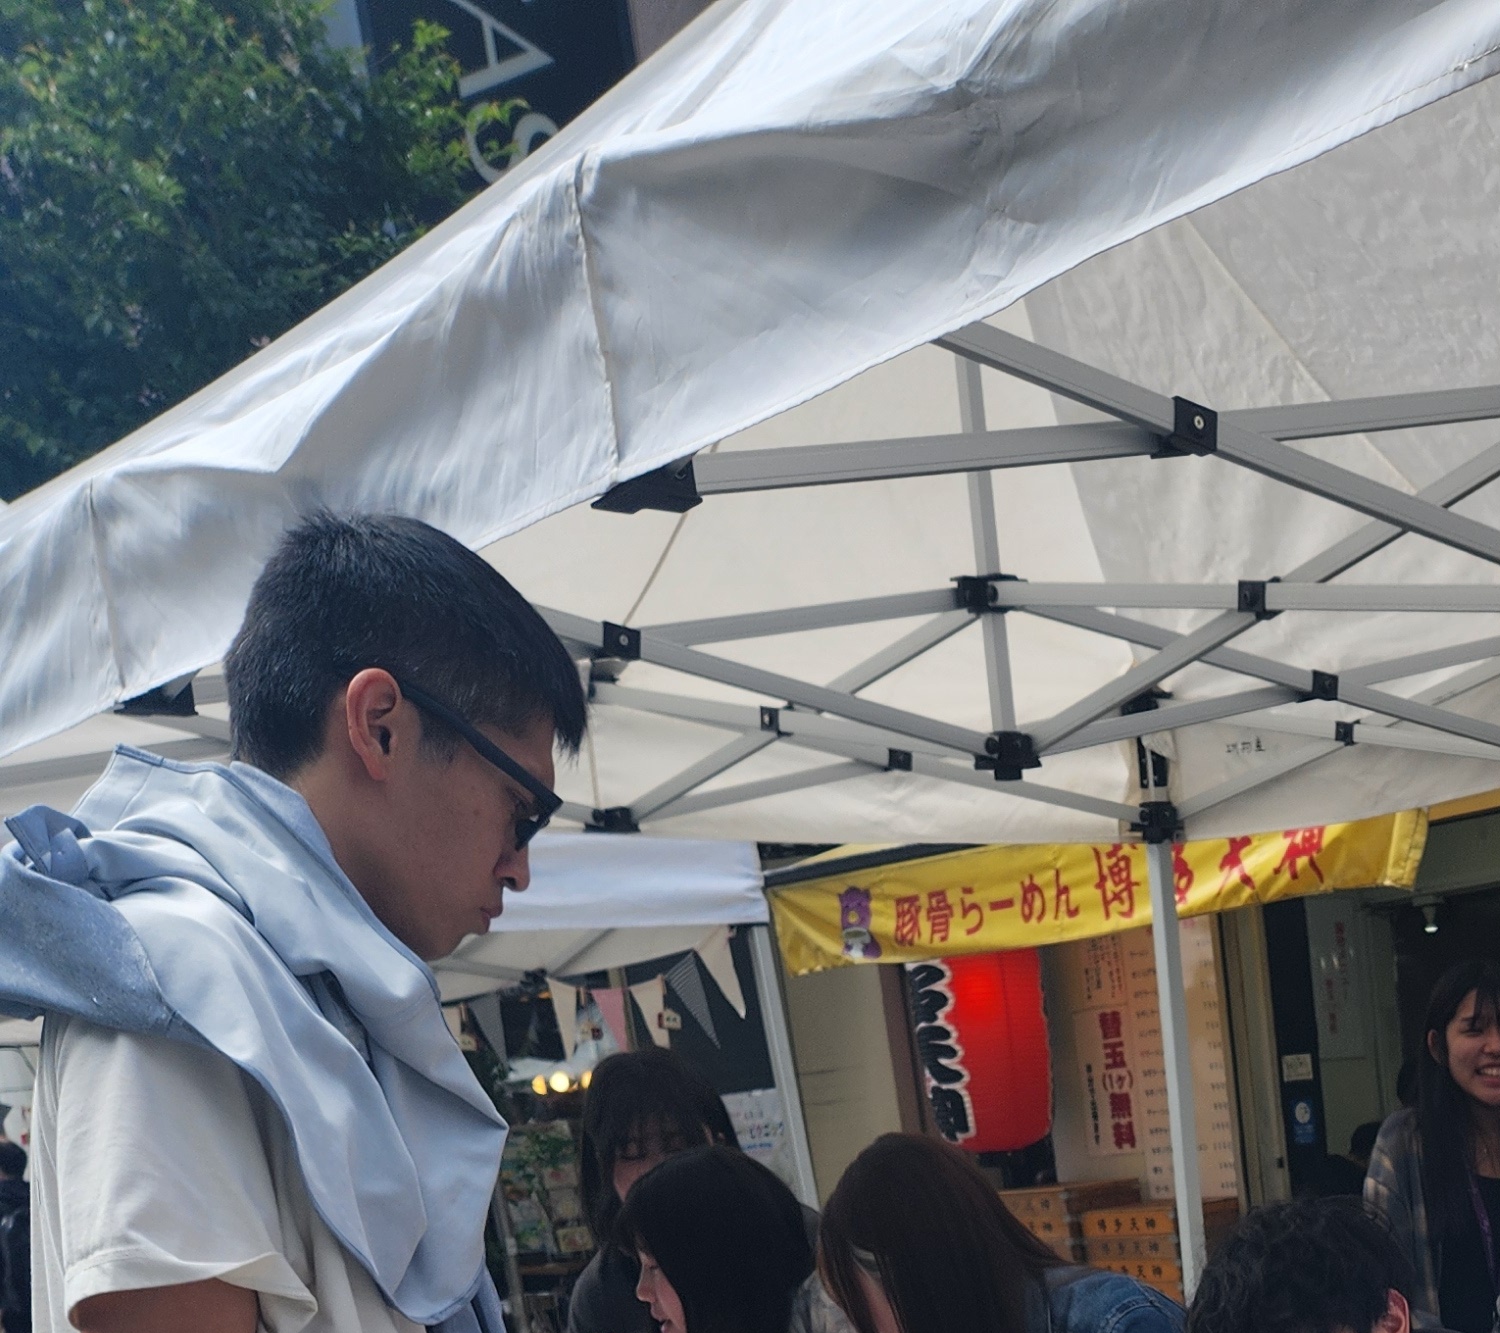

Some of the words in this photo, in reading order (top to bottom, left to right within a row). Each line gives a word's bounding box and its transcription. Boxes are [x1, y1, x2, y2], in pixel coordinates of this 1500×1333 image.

[893, 869, 1081, 947] 豚骨らーめん
